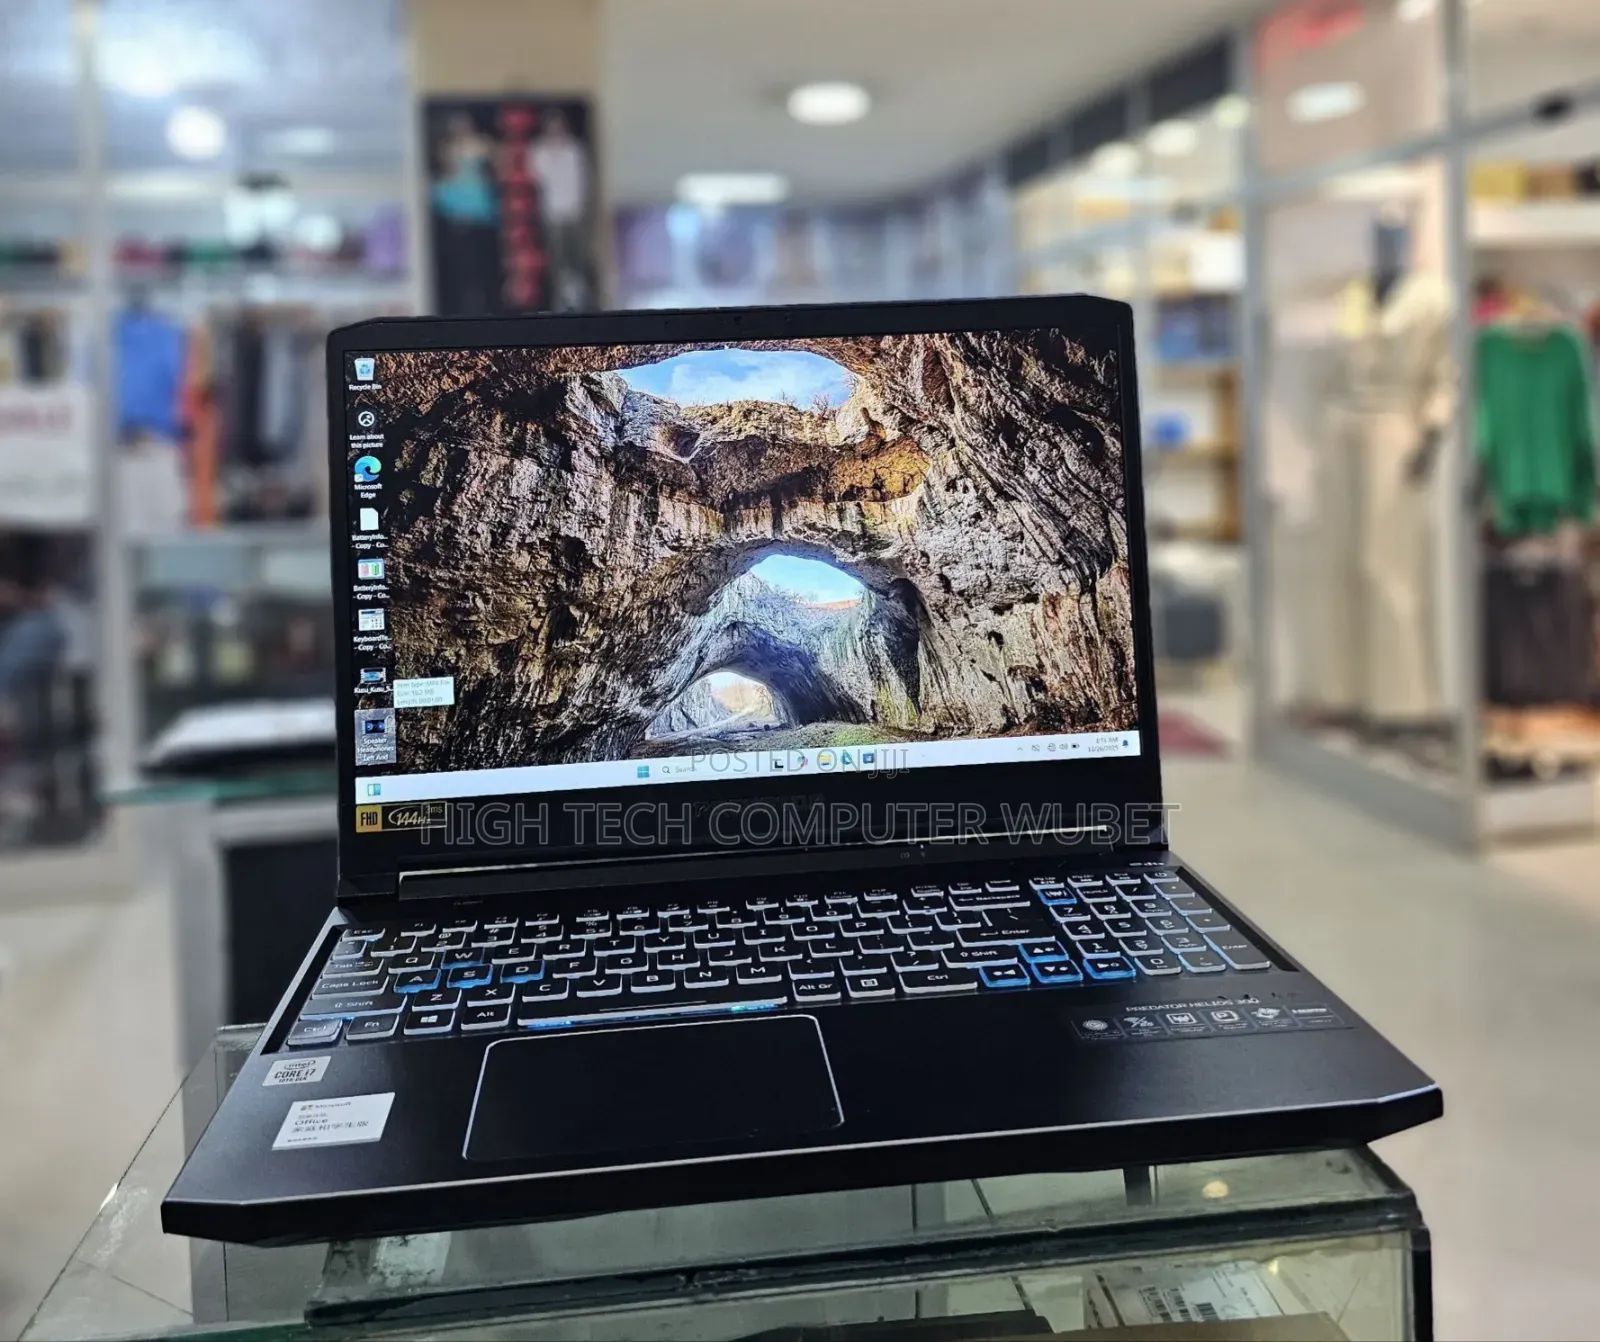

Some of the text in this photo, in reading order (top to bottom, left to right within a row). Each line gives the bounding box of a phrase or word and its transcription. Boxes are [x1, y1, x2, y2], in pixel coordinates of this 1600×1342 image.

[360, 491, 376, 499] Edge
[358, 643, 374, 651] Copy
[361, 811, 378, 826] FHD
[708, 932, 720, 940] U
[508, 947, 520, 955] E
[569, 961, 581, 969] F
[750, 966, 766, 974] M
[408, 975, 424, 983] A
[322, 979, 379, 990] Caps Lock
[539, 984, 551, 992] C
[485, 988, 498, 996] X
[430, 993, 443, 1001] Z
[347, 1000, 373, 1008] Shift
[1126, 1003, 1187, 1012] PREDATOR
[1189, 1000, 1234, 1008] HELIOS
[303, 1025, 328, 1033] Ctrl
[274, 1069, 304, 1079] CORE
